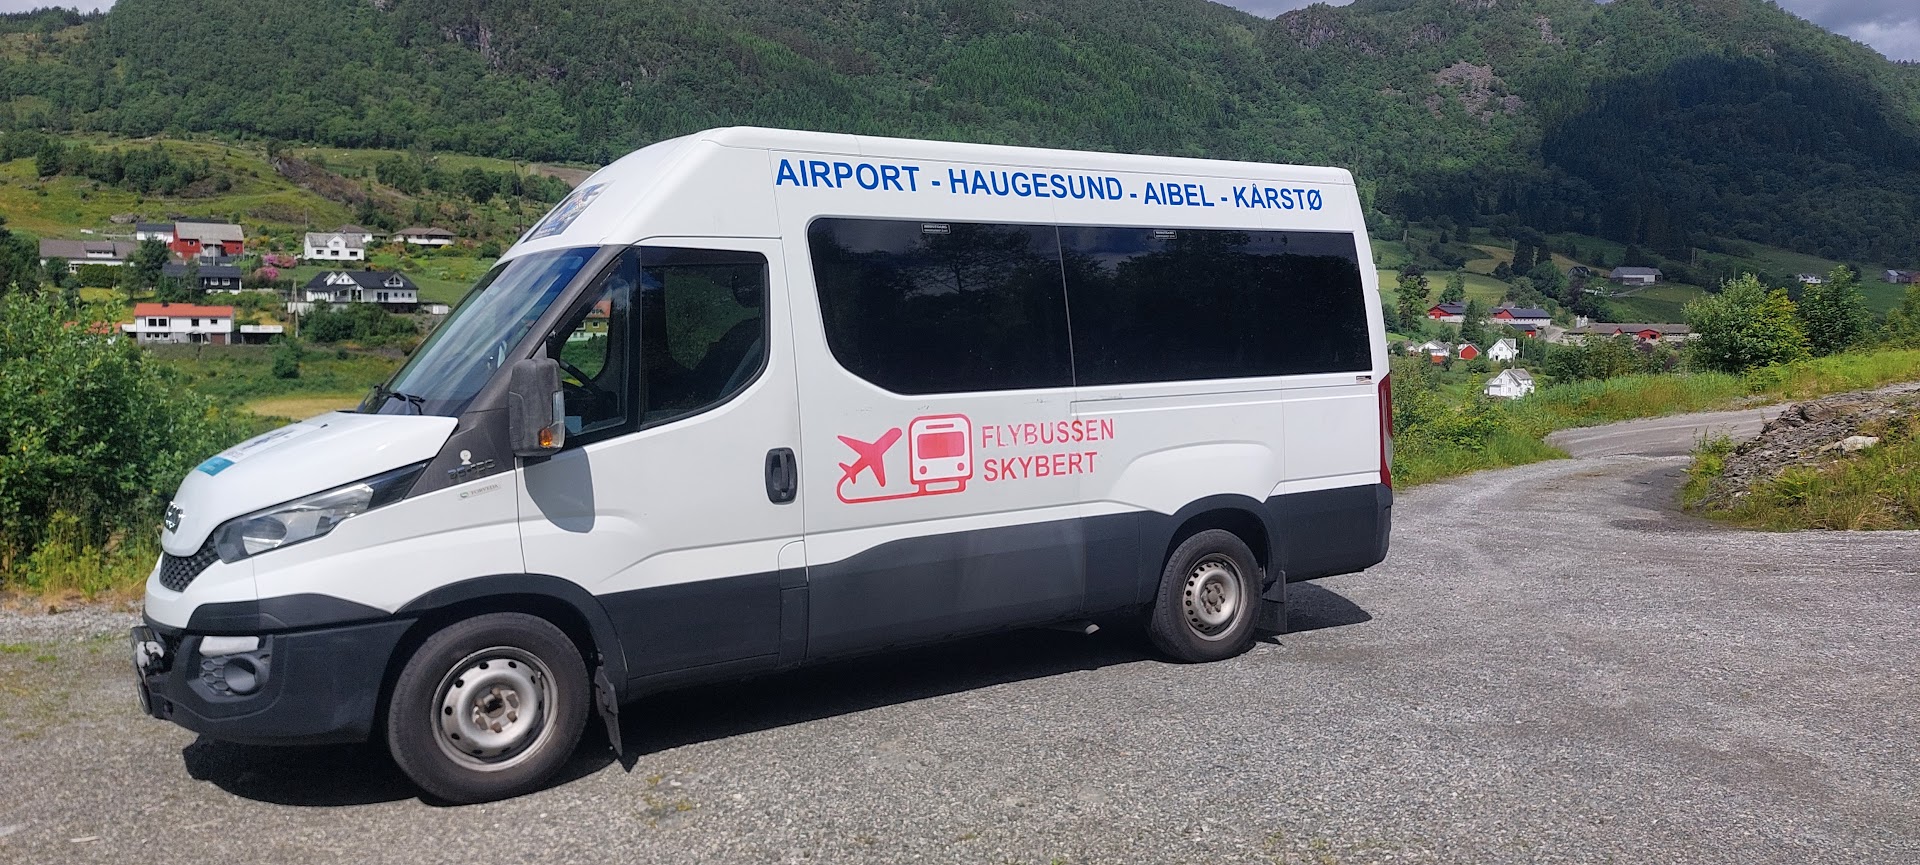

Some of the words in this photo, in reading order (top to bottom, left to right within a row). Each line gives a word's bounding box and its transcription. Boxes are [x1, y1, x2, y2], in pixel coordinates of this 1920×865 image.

[776, 159, 919, 192] AIRPORT
[948, 168, 1123, 201] HAUGESUND
[1144, 182, 1215, 208] AIBEL
[1233, 183, 1322, 211] KÅRSTØ
[981, 418, 1115, 449] FLYBUSSEN
[983, 451, 1098, 483] SKYBERT
